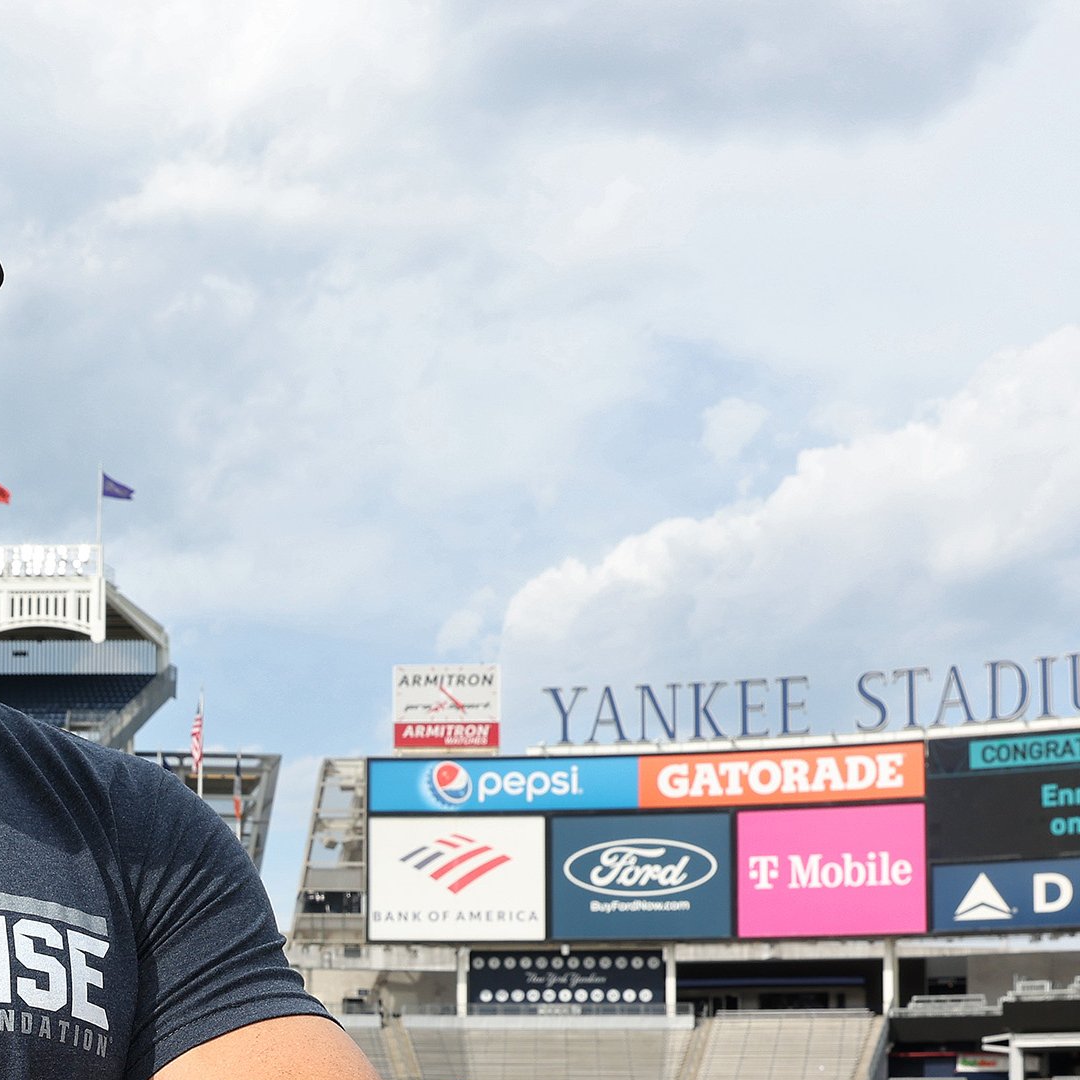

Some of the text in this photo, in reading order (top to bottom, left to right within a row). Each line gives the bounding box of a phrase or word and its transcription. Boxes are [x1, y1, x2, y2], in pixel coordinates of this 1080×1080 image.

[398, 673, 494, 687] ARMITRON
[542, 675, 811, 746] YANKEE
[402, 723, 490, 738] ARMITRON
[478, 765, 580, 803] pepsi
[657, 753, 905, 798] GATORADE
[1041, 783, 1080, 808] En
[590, 847, 690, 887] Ford
[788, 851, 913, 889] Mobile
[589, 899, 691, 914] BuyFordNow.com
[1033, 872, 1073, 914] D
[373, 910, 539, 922] BANK OF AMERICA
